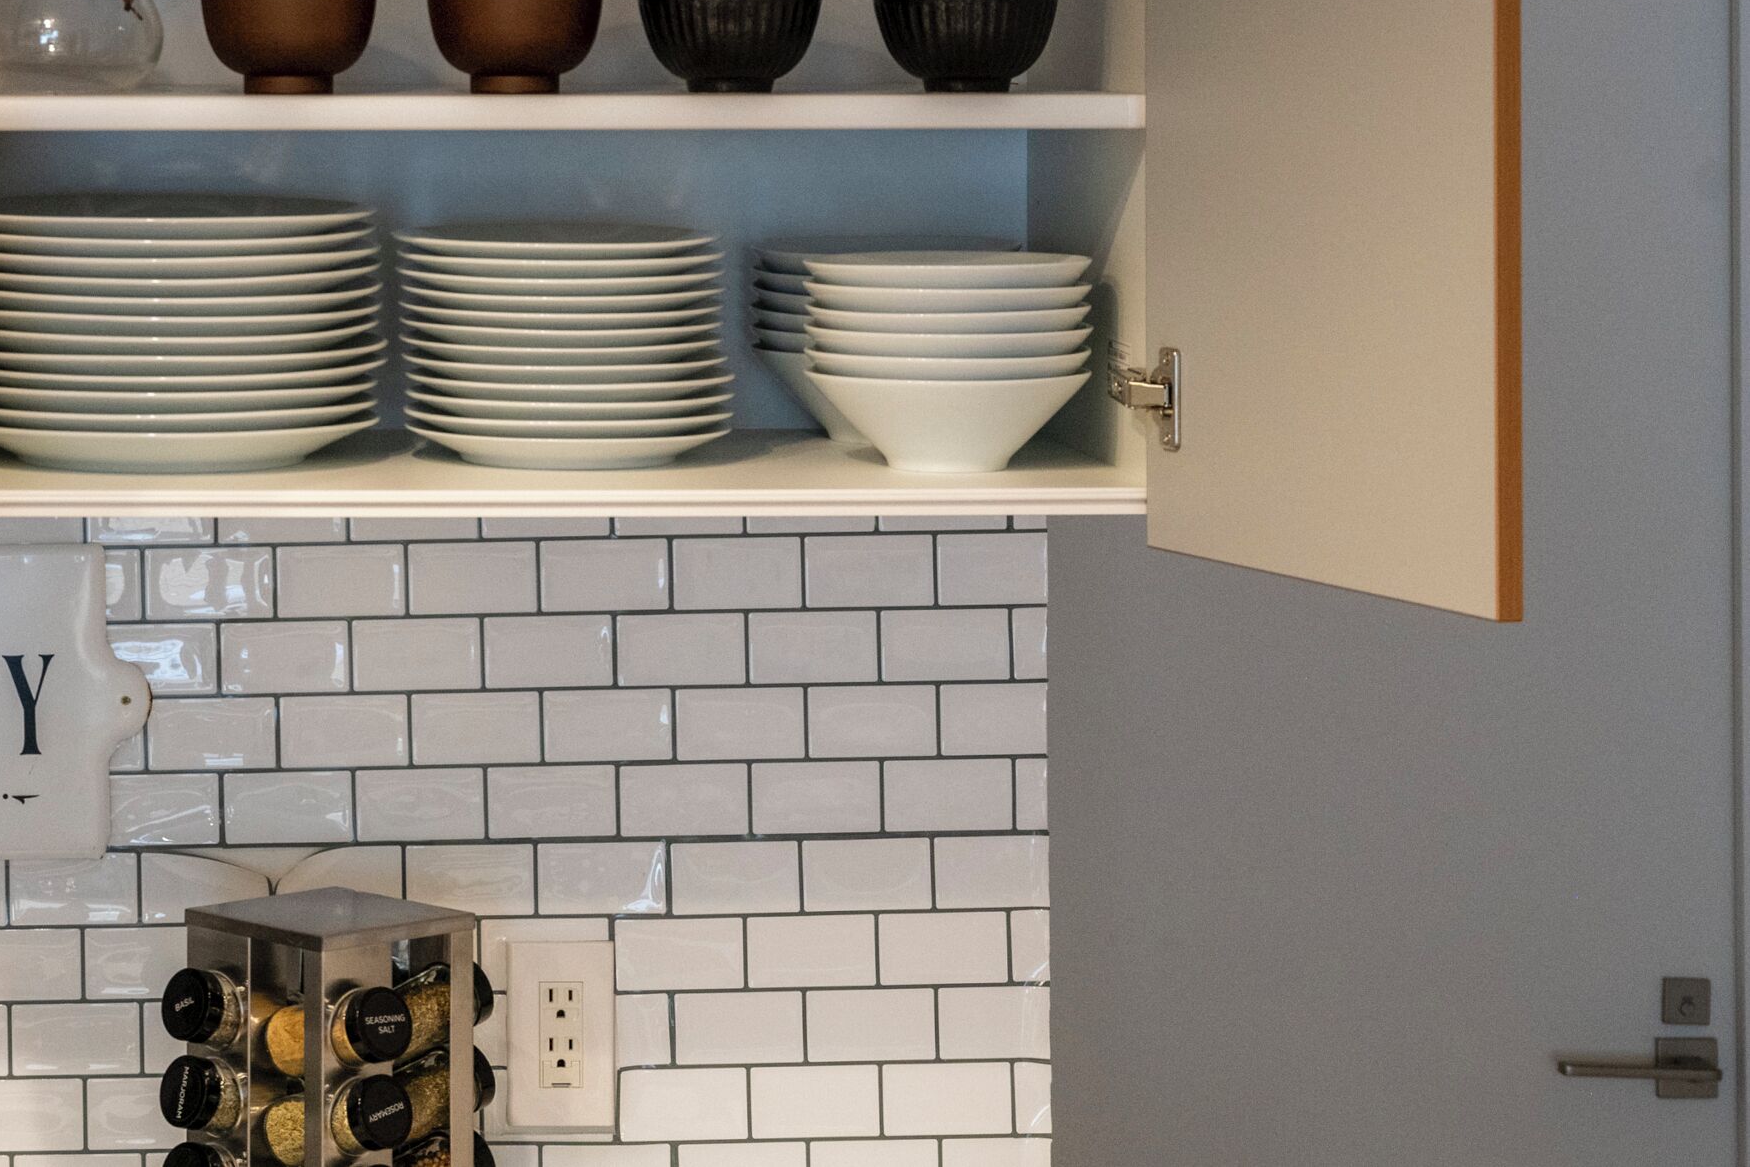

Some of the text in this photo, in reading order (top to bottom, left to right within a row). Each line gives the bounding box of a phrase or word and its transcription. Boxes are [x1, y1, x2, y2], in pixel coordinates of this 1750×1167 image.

[174, 996, 195, 1012] BASIL
[365, 1013, 406, 1025] SEASONING
[378, 1025, 395, 1034] SALT
[176, 1066, 190, 1119] MARJORAM
[369, 1101, 404, 1123] ROSEMARY
